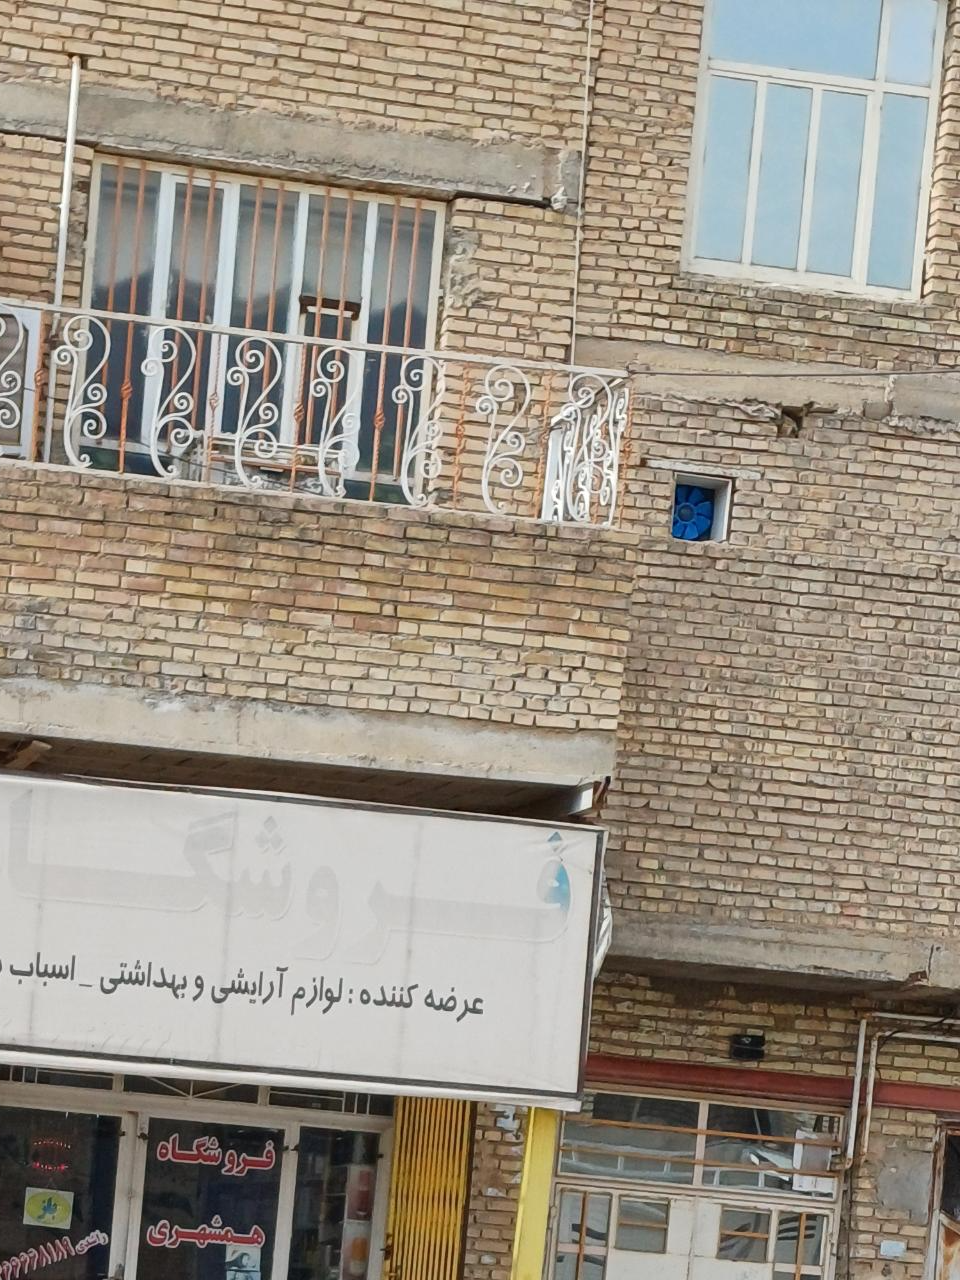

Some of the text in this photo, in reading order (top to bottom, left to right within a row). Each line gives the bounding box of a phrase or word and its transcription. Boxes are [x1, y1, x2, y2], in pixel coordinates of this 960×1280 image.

[9, 951, 76, 986] اسباب
[100, 958, 188, 1000] بهداشتی
[211, 966, 288, 1005] آرایشی
[192, 977, 204, 1001] و
[290, 976, 344, 1015] لوازم
[423, 985, 484, 1023] عرضه
[157, 1132, 276, 1176] فروشگاه
[146, 1214, 266, 1249] همشهری
